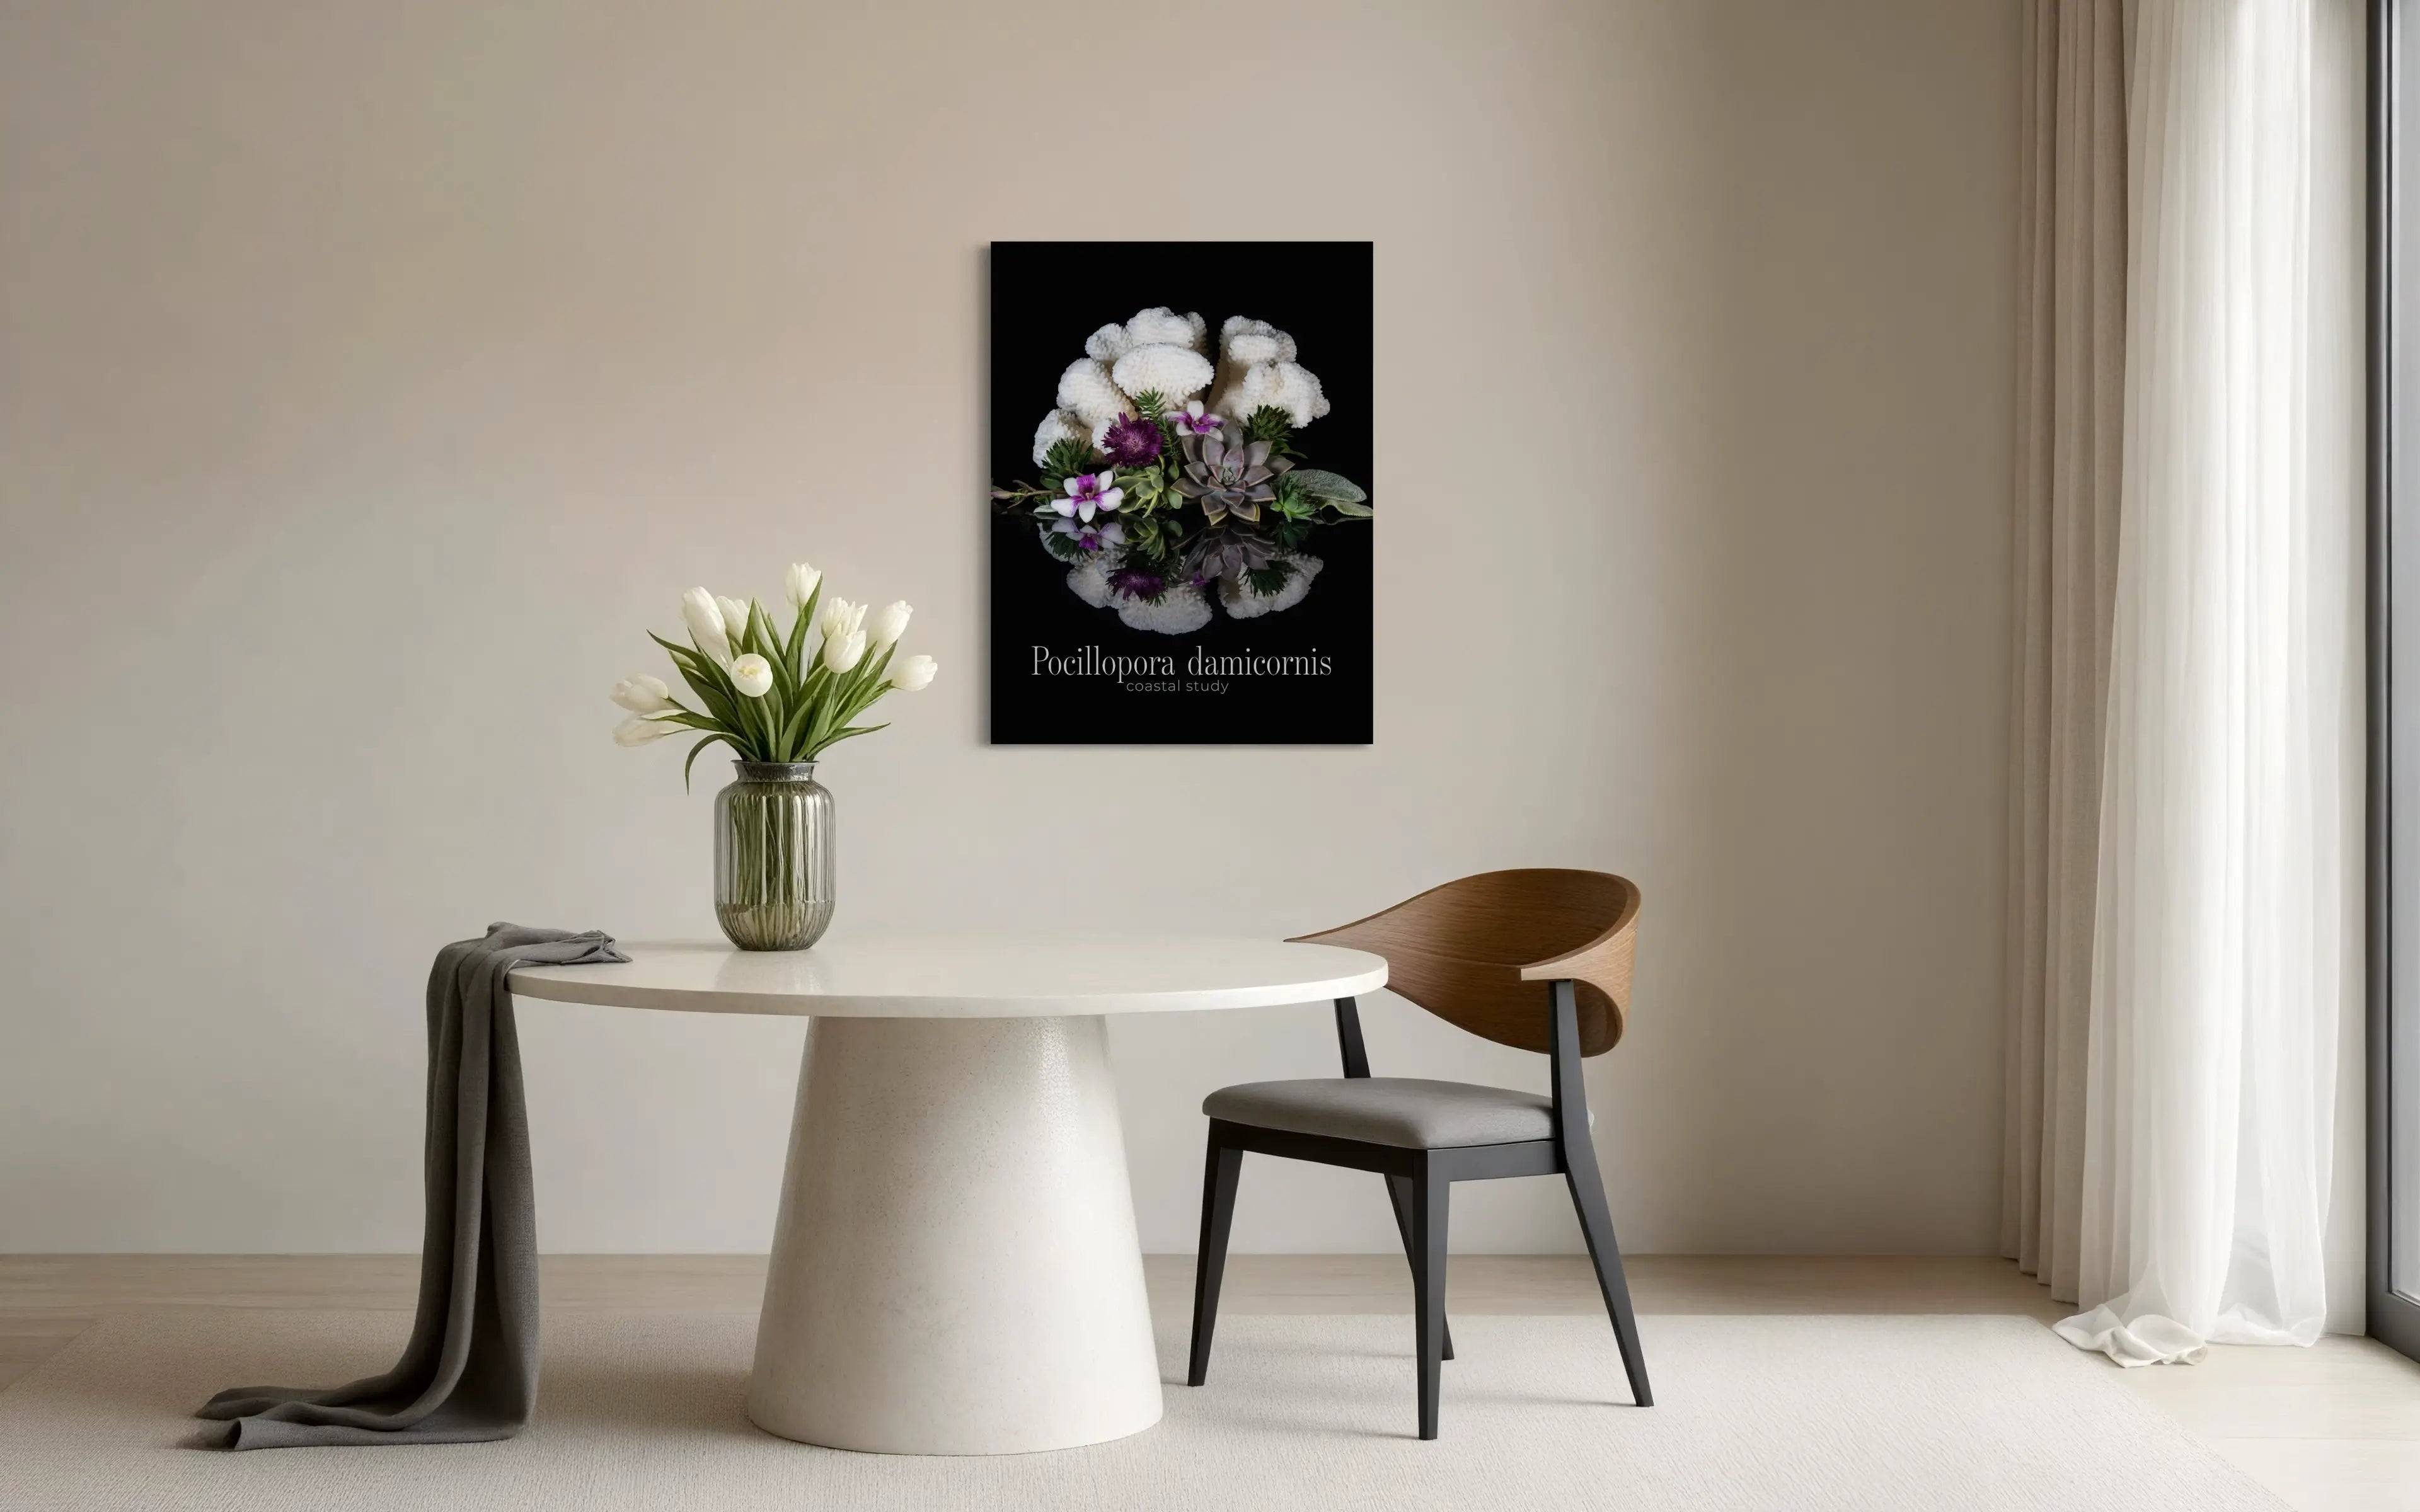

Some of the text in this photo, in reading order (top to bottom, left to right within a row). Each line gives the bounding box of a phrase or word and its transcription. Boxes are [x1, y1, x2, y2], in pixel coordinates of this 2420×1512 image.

[1031, 645, 1332, 684] Pocillopora damicornis
[1126, 679, 1230, 694] coastal study
